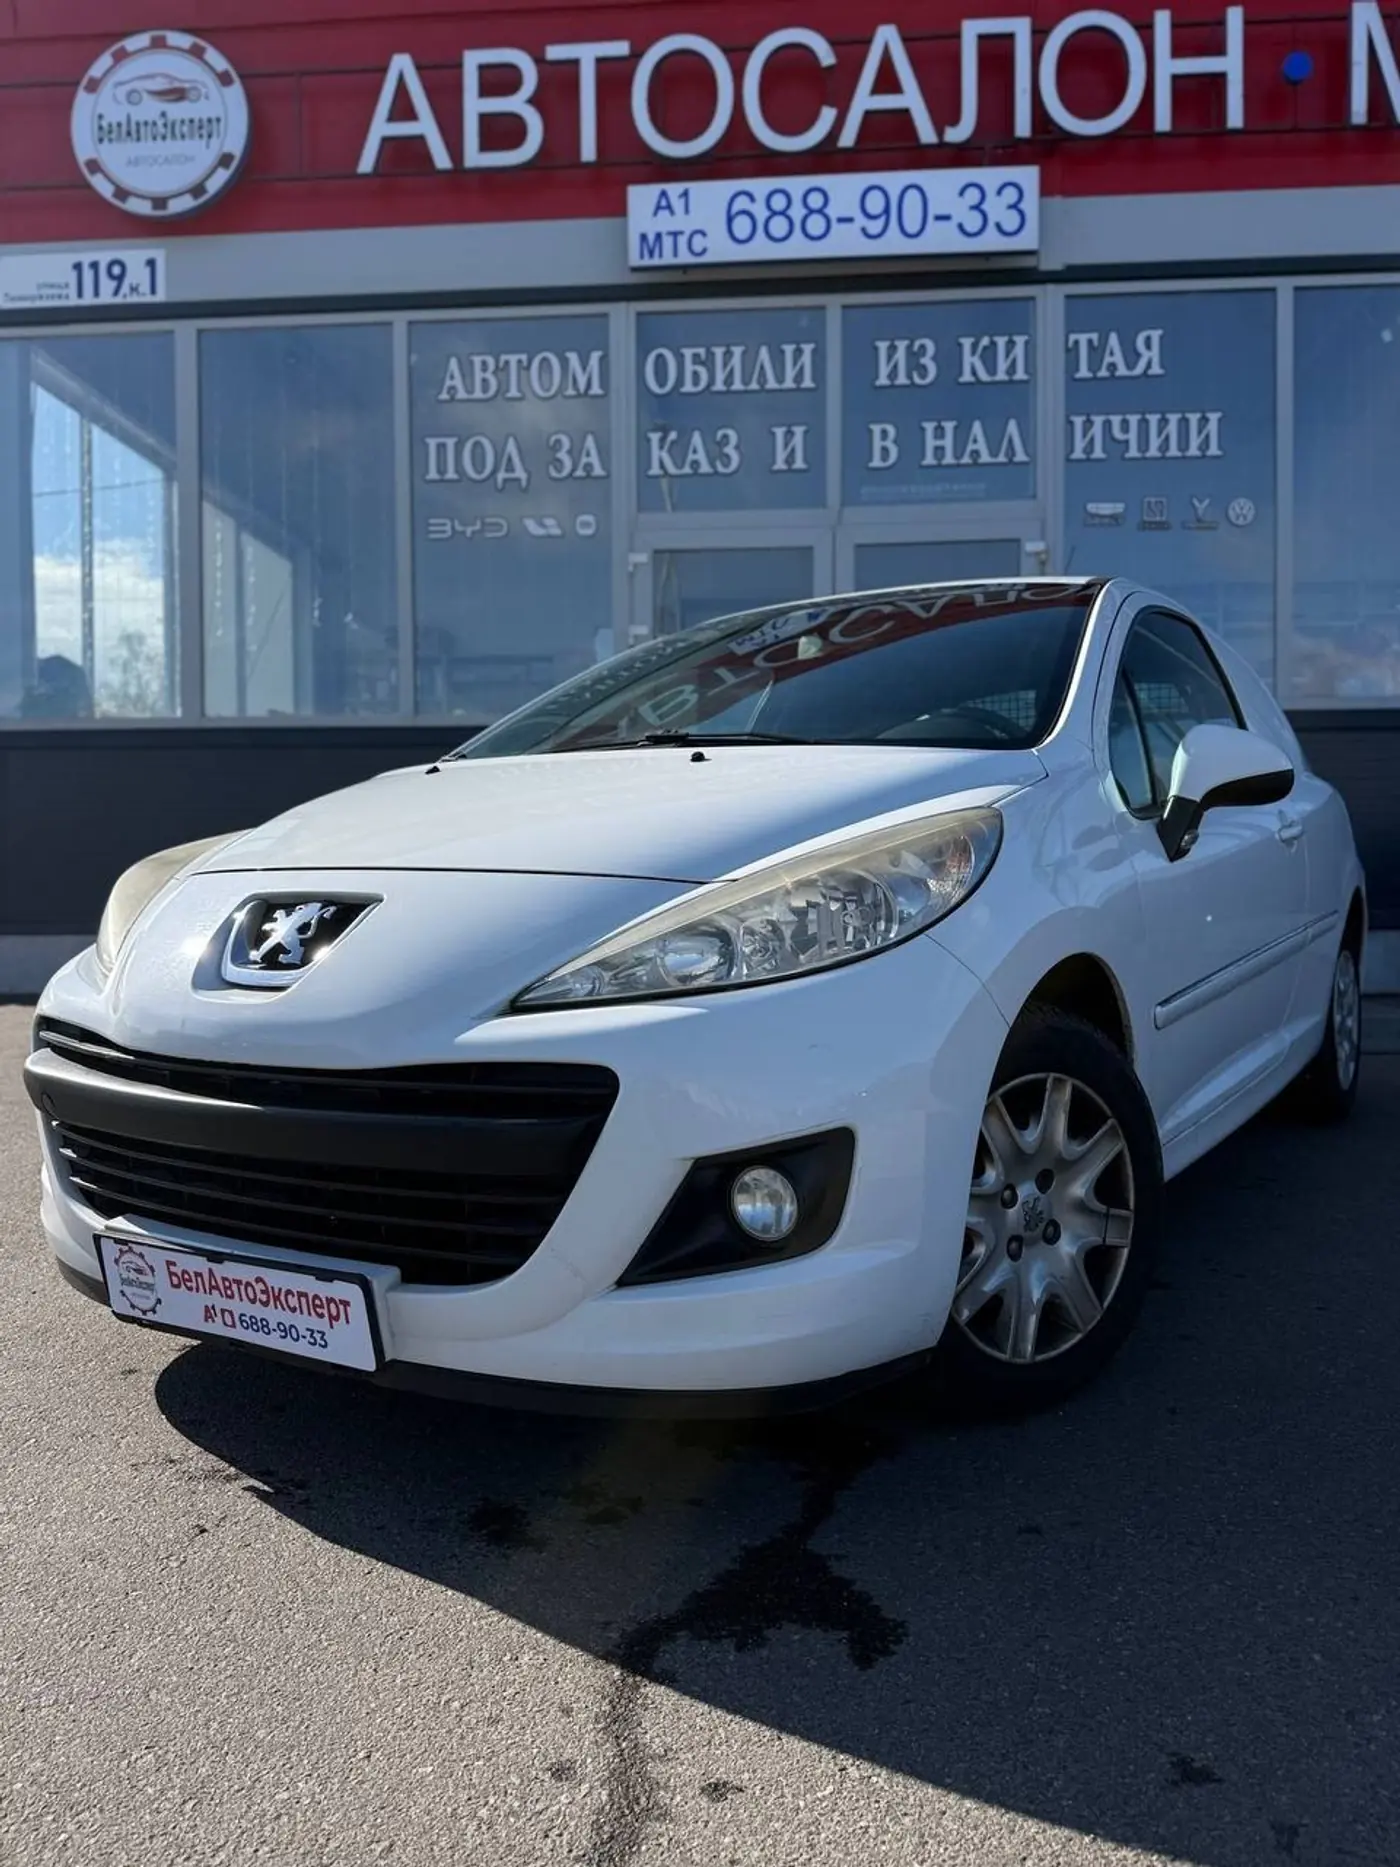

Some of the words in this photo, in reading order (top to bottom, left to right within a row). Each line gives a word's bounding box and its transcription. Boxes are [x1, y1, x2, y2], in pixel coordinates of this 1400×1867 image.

[357, 6, 1244, 174] АВТОСАЛОН
[96, 110, 222, 150] БелАвтоЭксперт
[653, 190, 691, 217] A1
[725, 181, 1027, 245] 688-90-33
[638, 229, 708, 261] МТС
[874, 338, 937, 387] ИЗ
[424, 435, 529, 491] ПОД
[770, 425, 808, 471] И
[868, 422, 898, 469] В
[165, 1259, 351, 1329] БелАвтоЭксперт
[239, 1312, 328, 1350] 688-90-33
